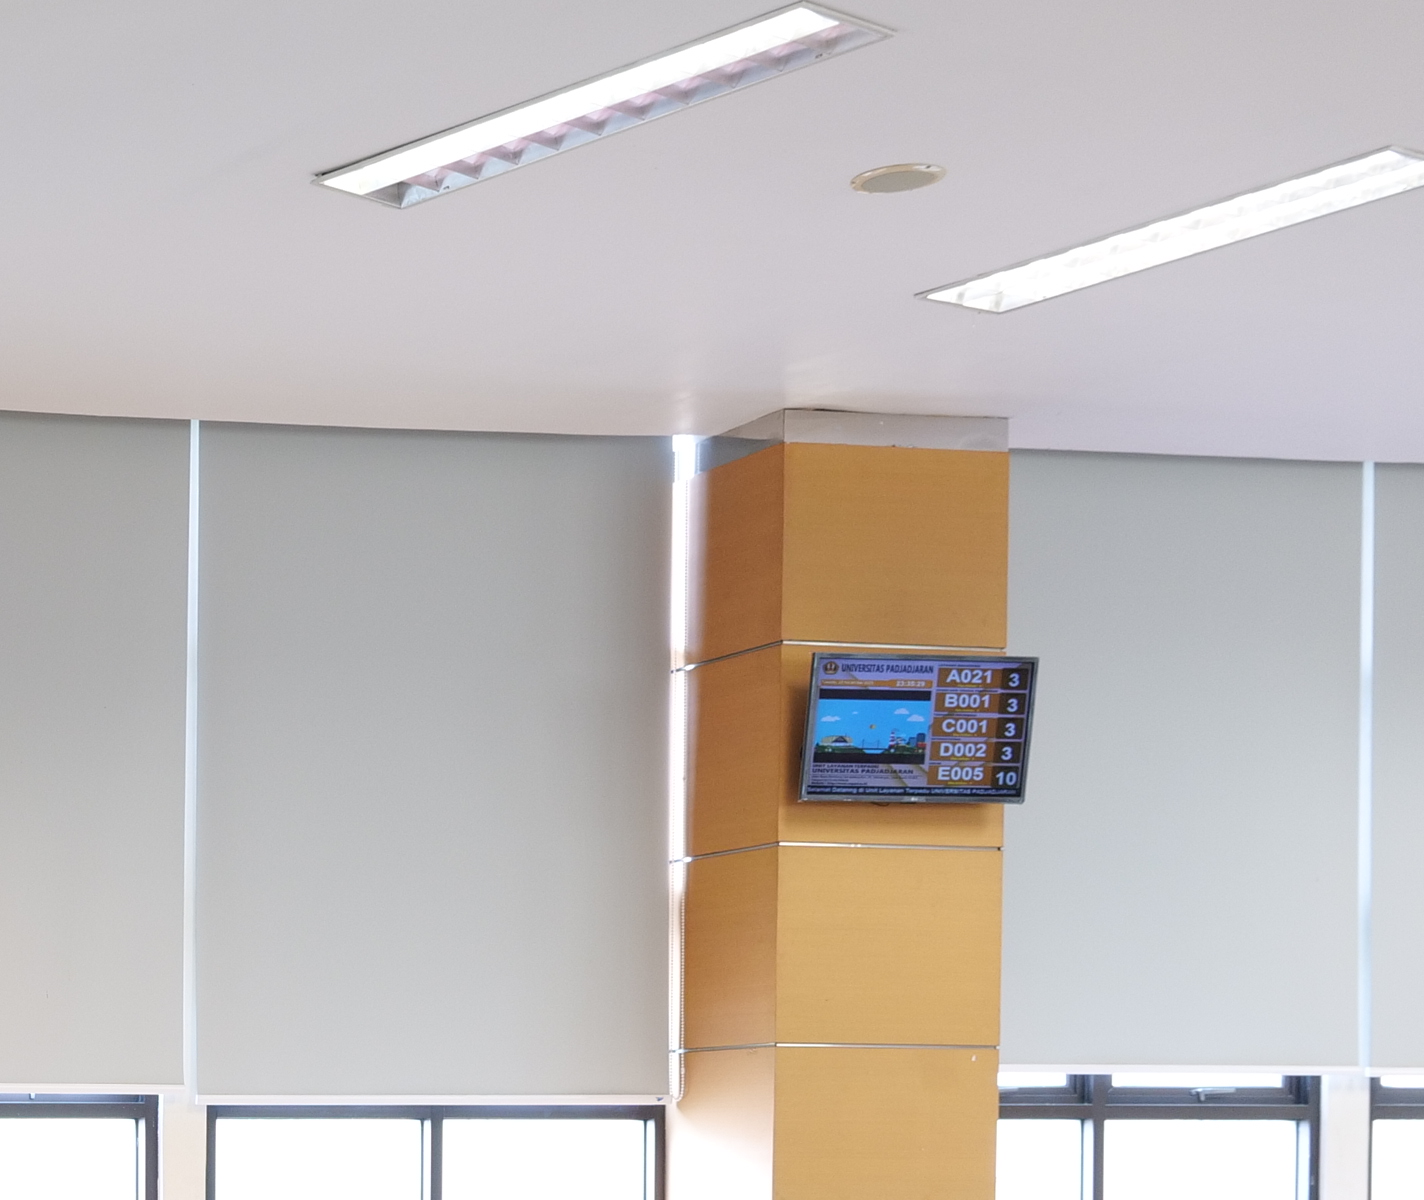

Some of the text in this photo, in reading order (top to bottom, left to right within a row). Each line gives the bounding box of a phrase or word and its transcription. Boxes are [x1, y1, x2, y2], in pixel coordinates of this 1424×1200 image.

[841, 662, 884, 674] UNIVERSITAS
[946, 669, 1020, 687] A021 3
[944, 693, 1018, 712] B001 3
[941, 718, 1016, 737] C001 3
[939, 742, 1012, 760] D002 3
[937, 766, 1017, 785] E005 10
